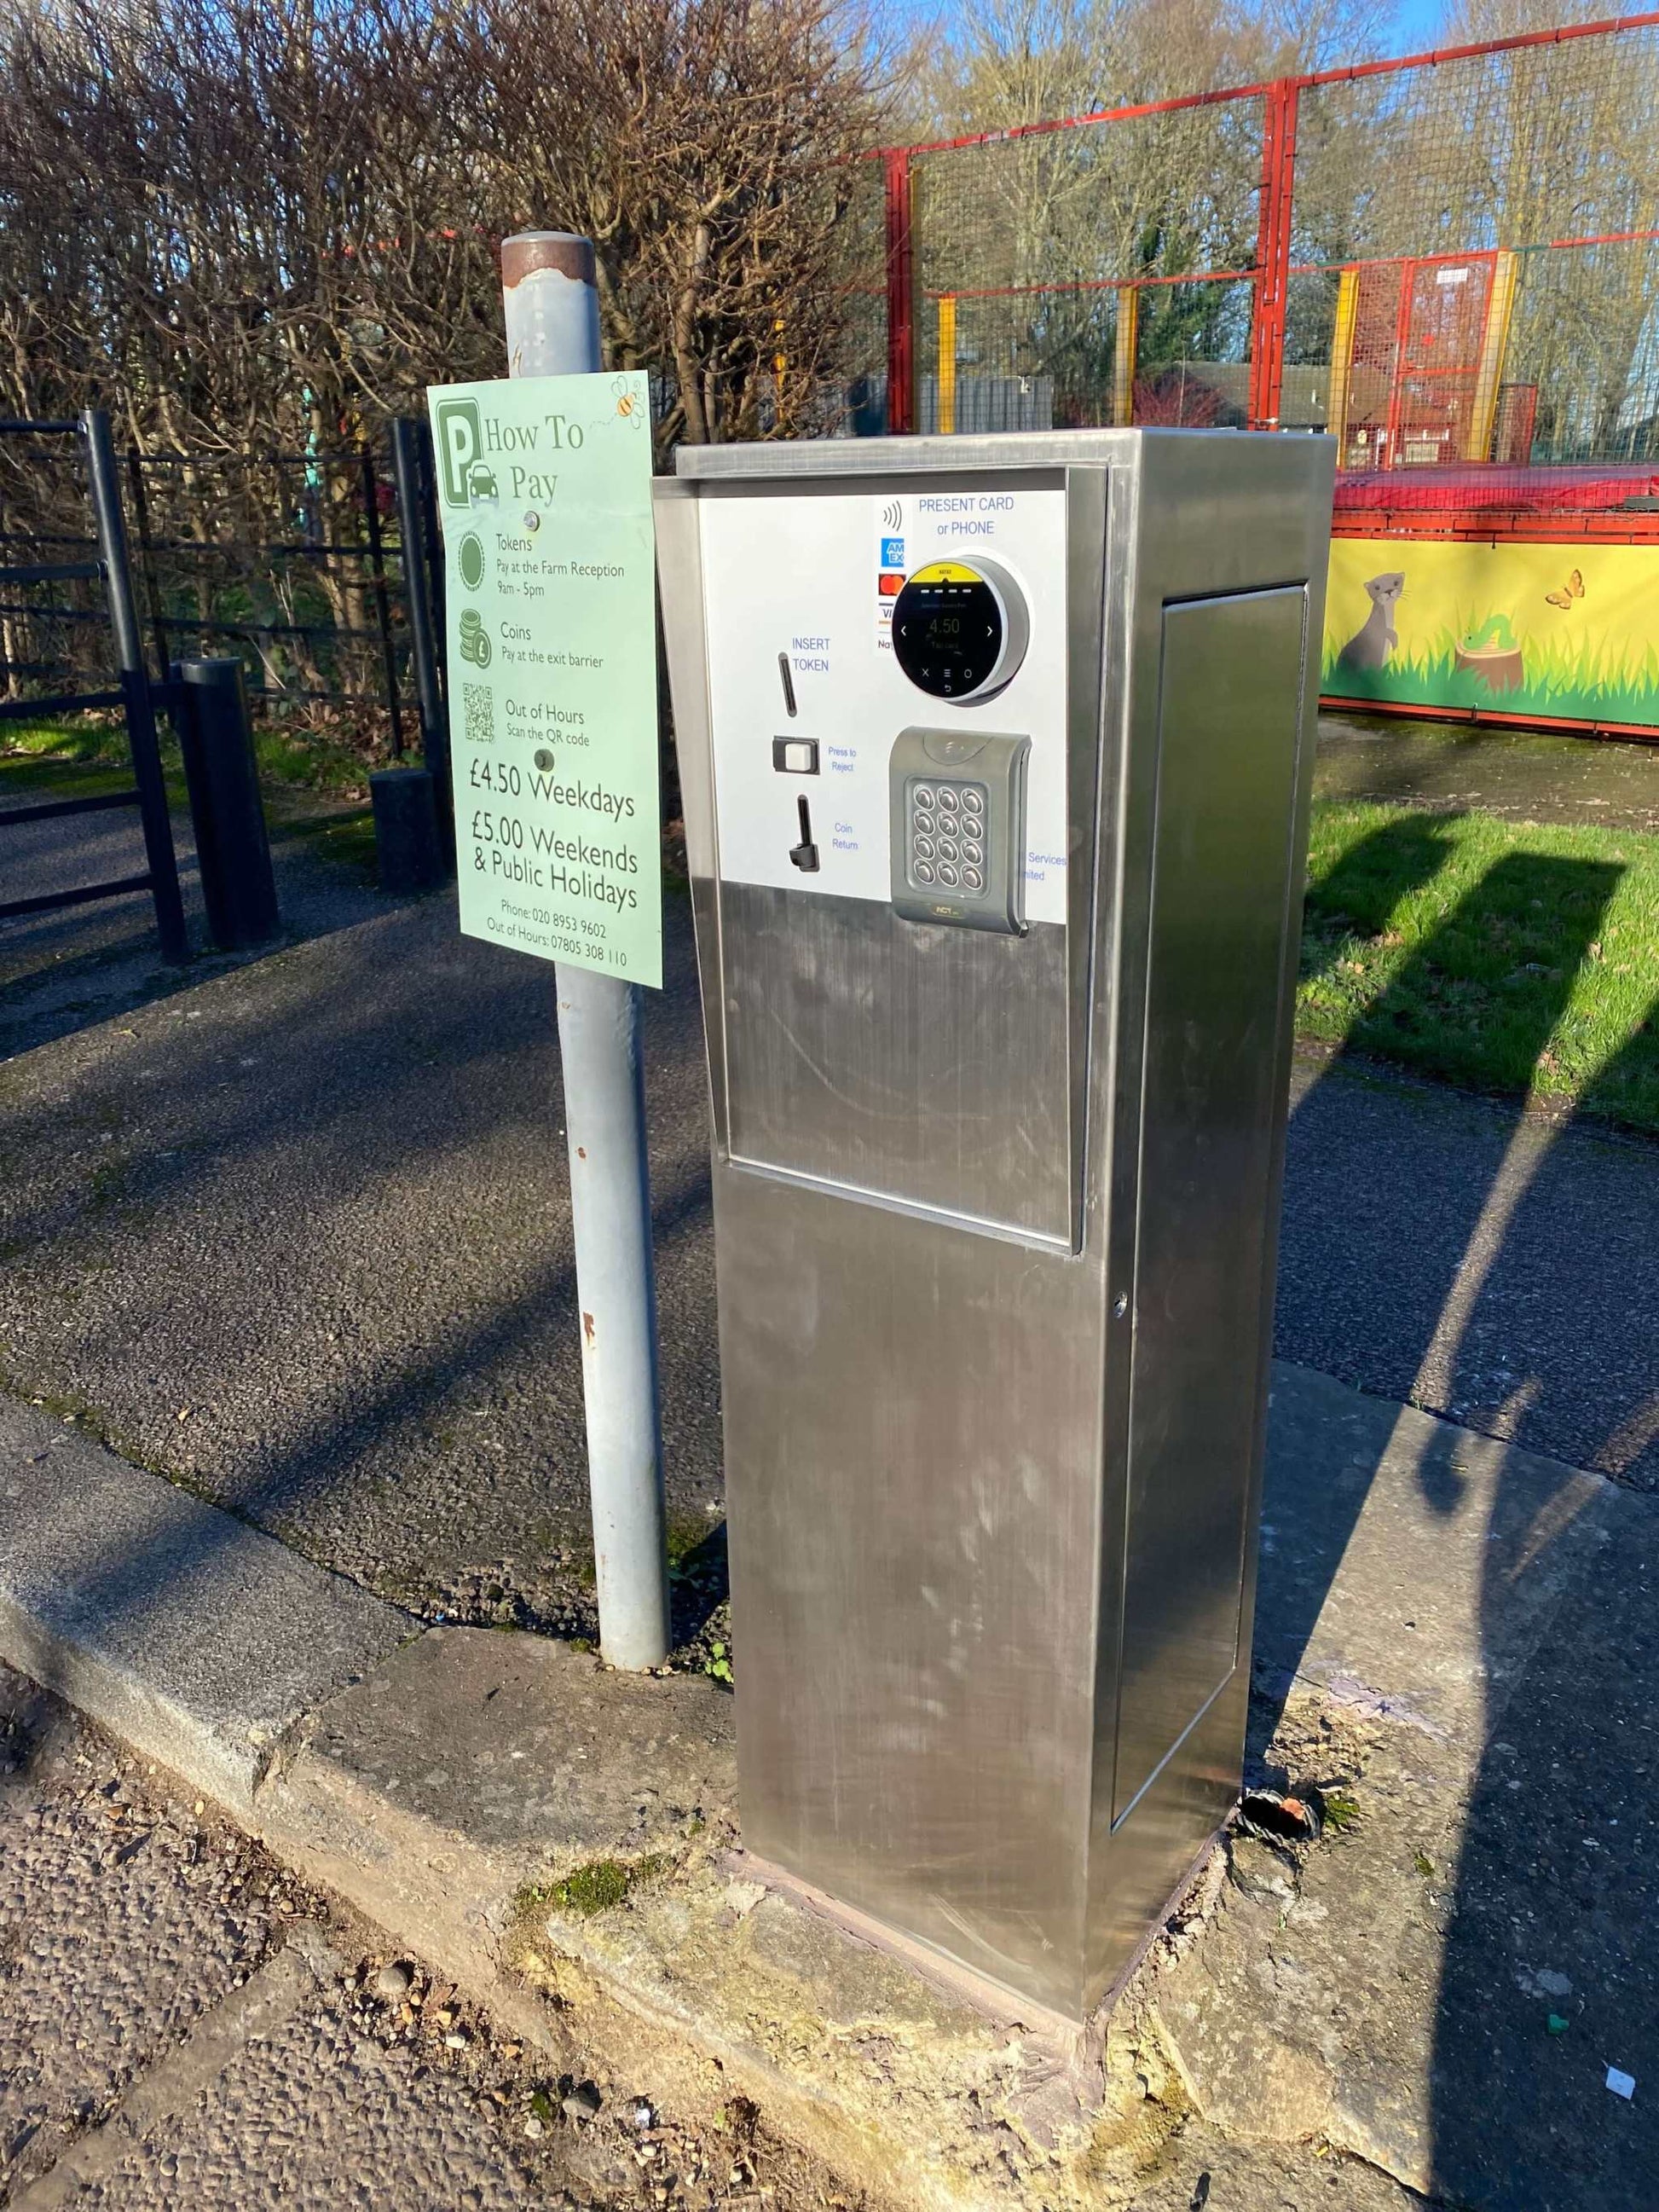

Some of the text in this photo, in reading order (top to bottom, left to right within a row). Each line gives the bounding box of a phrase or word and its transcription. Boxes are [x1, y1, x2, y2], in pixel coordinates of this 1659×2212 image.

[484, 414, 584, 452] How To
[446, 414, 474, 493] P
[510, 465, 558, 507] Pay
[919, 496, 1014, 512] PRESENT CARD
[937, 521, 995, 536] or PHONE
[496, 534, 532, 552] Tokens
[887, 542, 904, 553] AM
[497, 559, 625, 579] Pay at the Farm Reception
[498, 581, 515, 594] 9am
[523, 582, 545, 599] 5pm
[500, 622, 531, 640] Coins
[929, 617, 960, 634] 4.50
[792, 638, 830, 651] INSERT
[502, 646, 604, 669] Pay at the exit barrier
[793, 658, 829, 672] TOKEN
[506, 699, 585, 725] Out of Hours
[506, 723, 590, 747] Scan the QR code
[828, 745, 857, 757] Press to
[831, 761, 854, 773] Reject
[470, 758, 635, 823] £4.50 Weekdays
[834, 822, 853, 834] Coin
[471, 810, 639, 874] £5.00 Weekends
[832, 839, 858, 851] Return
[1028, 852, 1067, 866] Services
[474, 847, 638, 913] & Public Holidays
[501, 899, 607, 939] Phone: 020 8953 9602
[487, 916, 627, 966] Out of Hours: 07805 308 110
